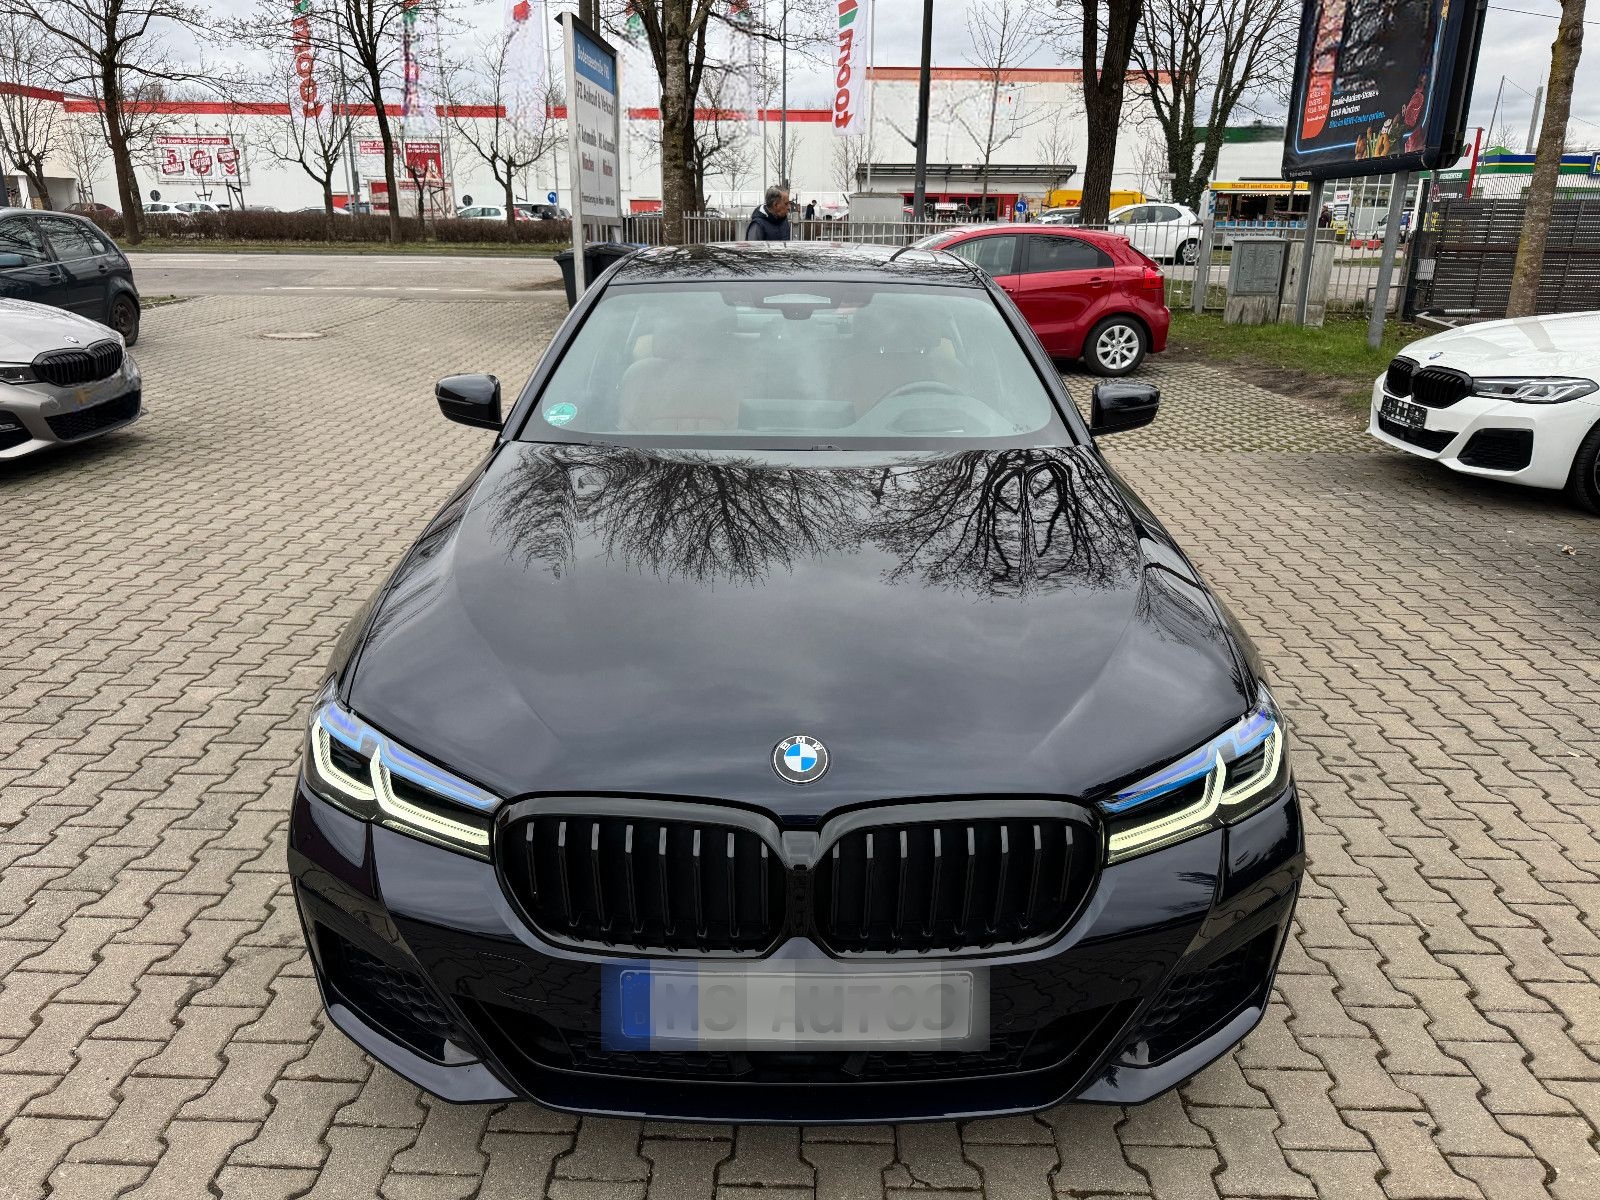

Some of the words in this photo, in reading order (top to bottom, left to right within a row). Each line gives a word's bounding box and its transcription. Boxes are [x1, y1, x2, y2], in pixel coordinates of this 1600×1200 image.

[835, 28, 854, 129] toom
[779, 736, 823, 751] BMW
[664, 983, 738, 1032] MS
[771, 983, 956, 1034] AUTOS
